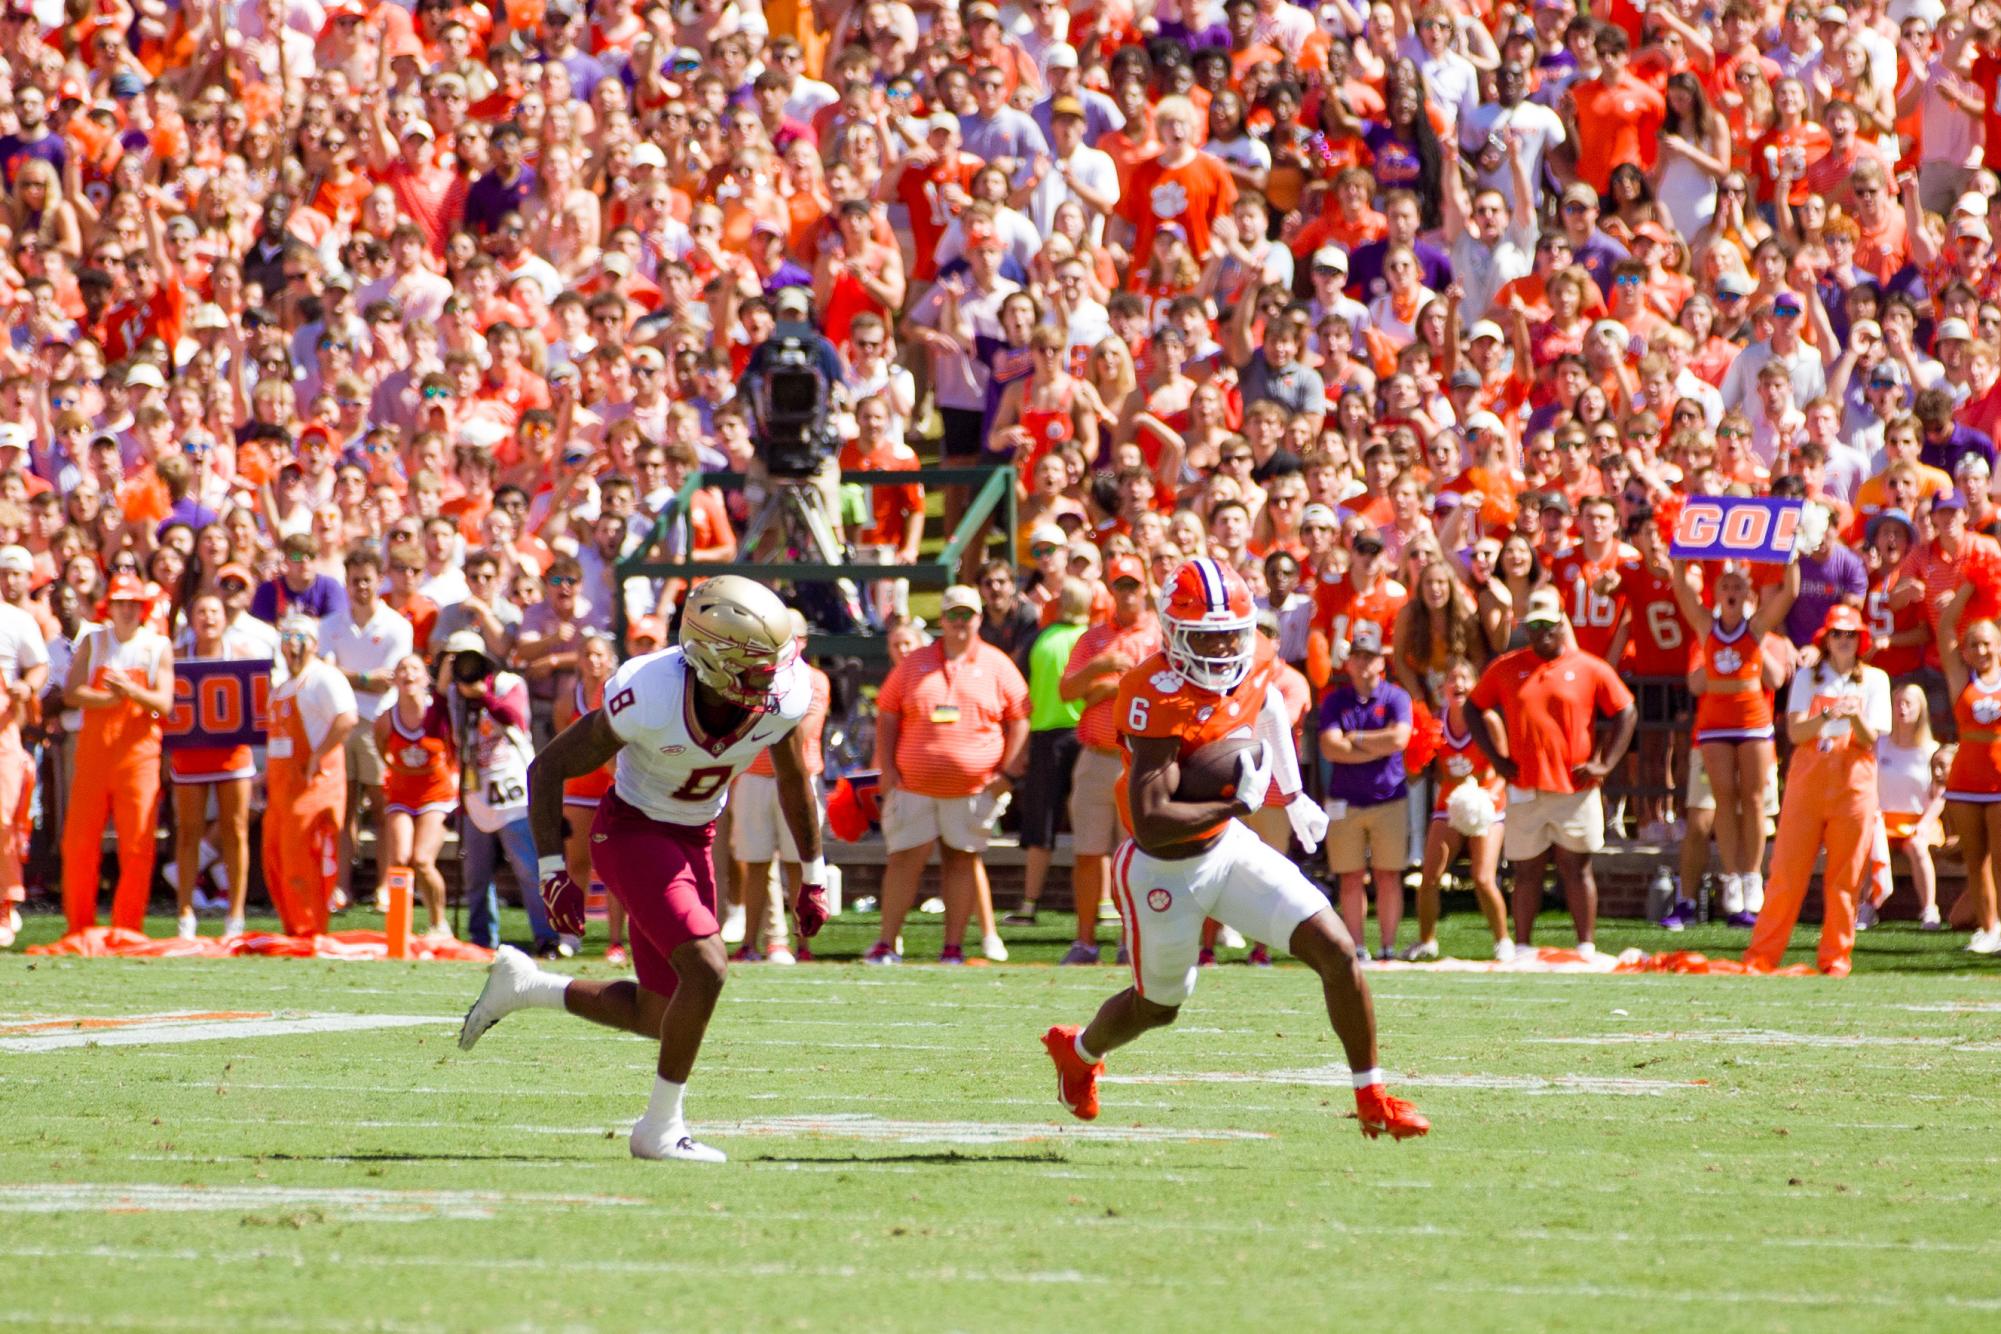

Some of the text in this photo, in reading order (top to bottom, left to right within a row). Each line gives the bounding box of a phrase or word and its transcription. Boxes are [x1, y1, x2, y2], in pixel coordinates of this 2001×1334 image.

[1674, 504, 1800, 552] GO!
[1646, 601, 1683, 650] 6
[1868, 592, 1895, 637] 5
[162, 673, 270, 735] GO!
[609, 688, 636, 717] 8
[1129, 697, 1150, 731] 6
[487, 777, 525, 806] 46
